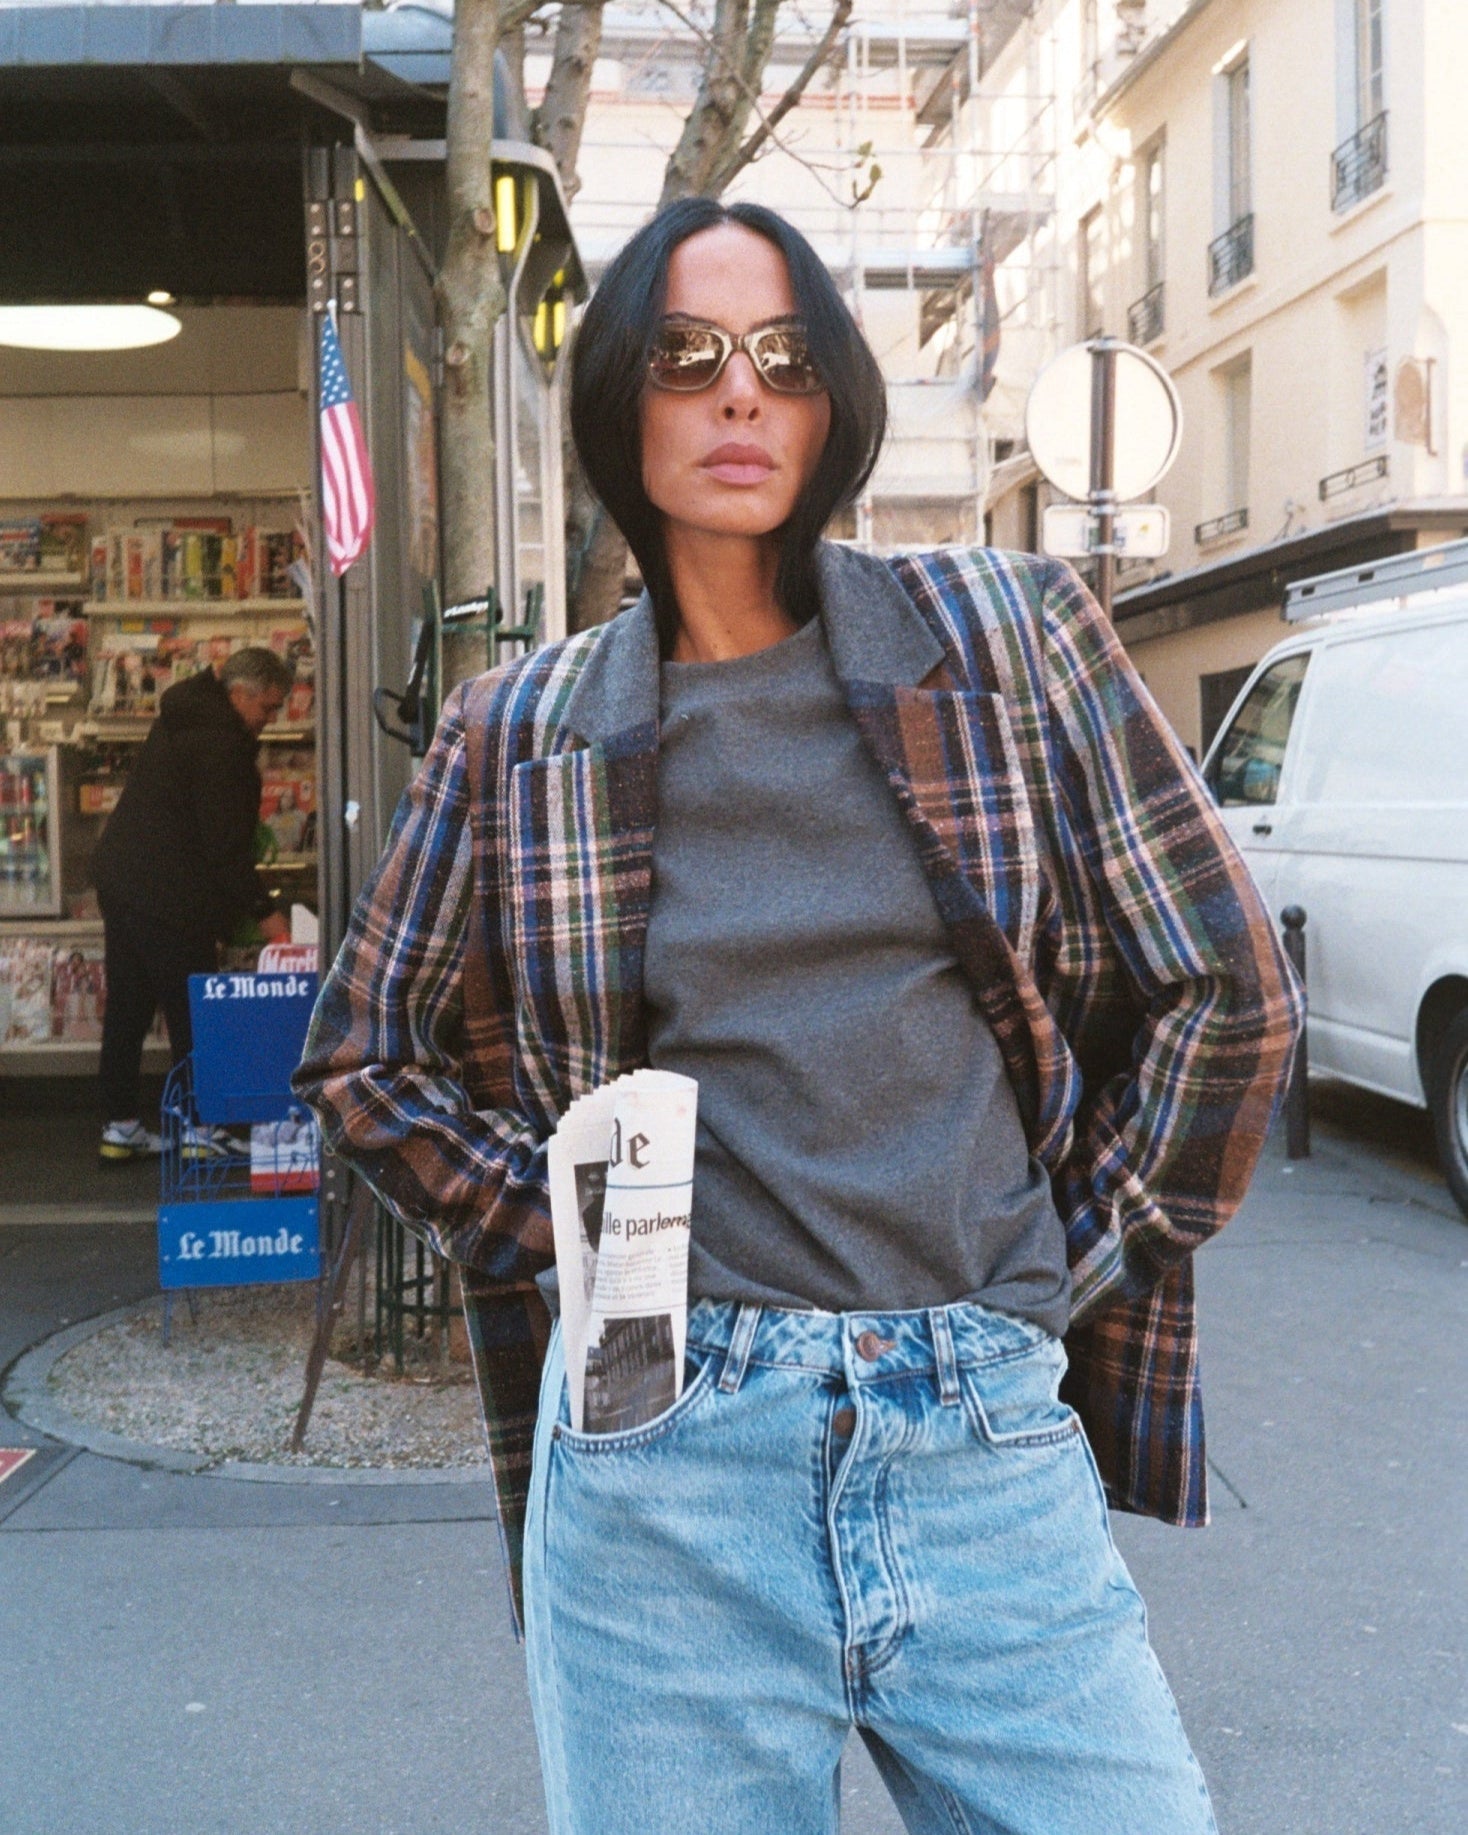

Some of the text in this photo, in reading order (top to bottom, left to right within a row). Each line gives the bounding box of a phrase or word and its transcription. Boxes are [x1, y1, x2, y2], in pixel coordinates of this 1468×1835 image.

[203, 975, 310, 1000] Le Monde
[176, 1227, 303, 1260] Le Monde
